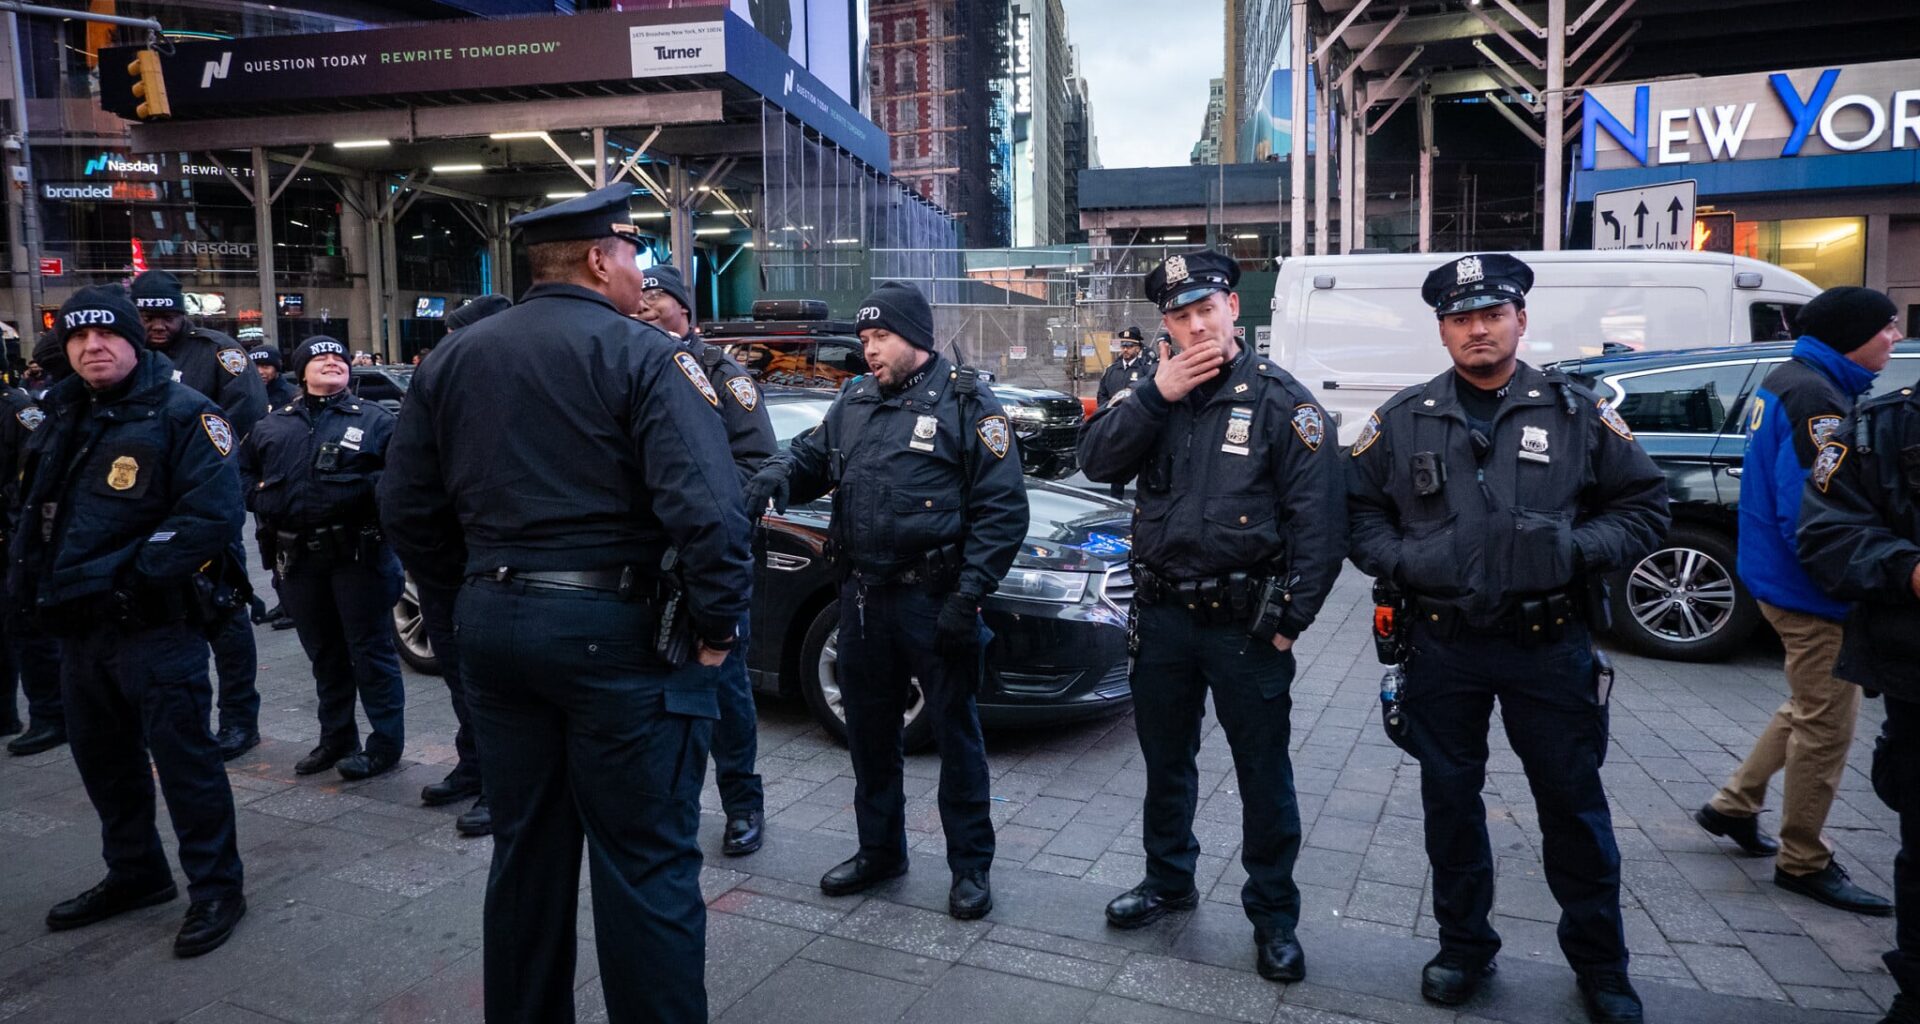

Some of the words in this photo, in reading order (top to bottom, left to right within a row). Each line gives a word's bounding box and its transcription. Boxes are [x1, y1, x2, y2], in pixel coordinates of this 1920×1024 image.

[653, 45, 702, 60] Turner
[244, 57, 315, 73] QUESTION
[321, 54, 367, 68] TODAY
[380, 49, 453, 64] REWRITE
[107, 160, 158, 175] Nasdaq
[184, 240, 251, 258] Nasdaq
[136, 298, 174, 308] NYPD
[64, 309, 115, 329] NYPD
[310, 341, 343, 355] NYPD
